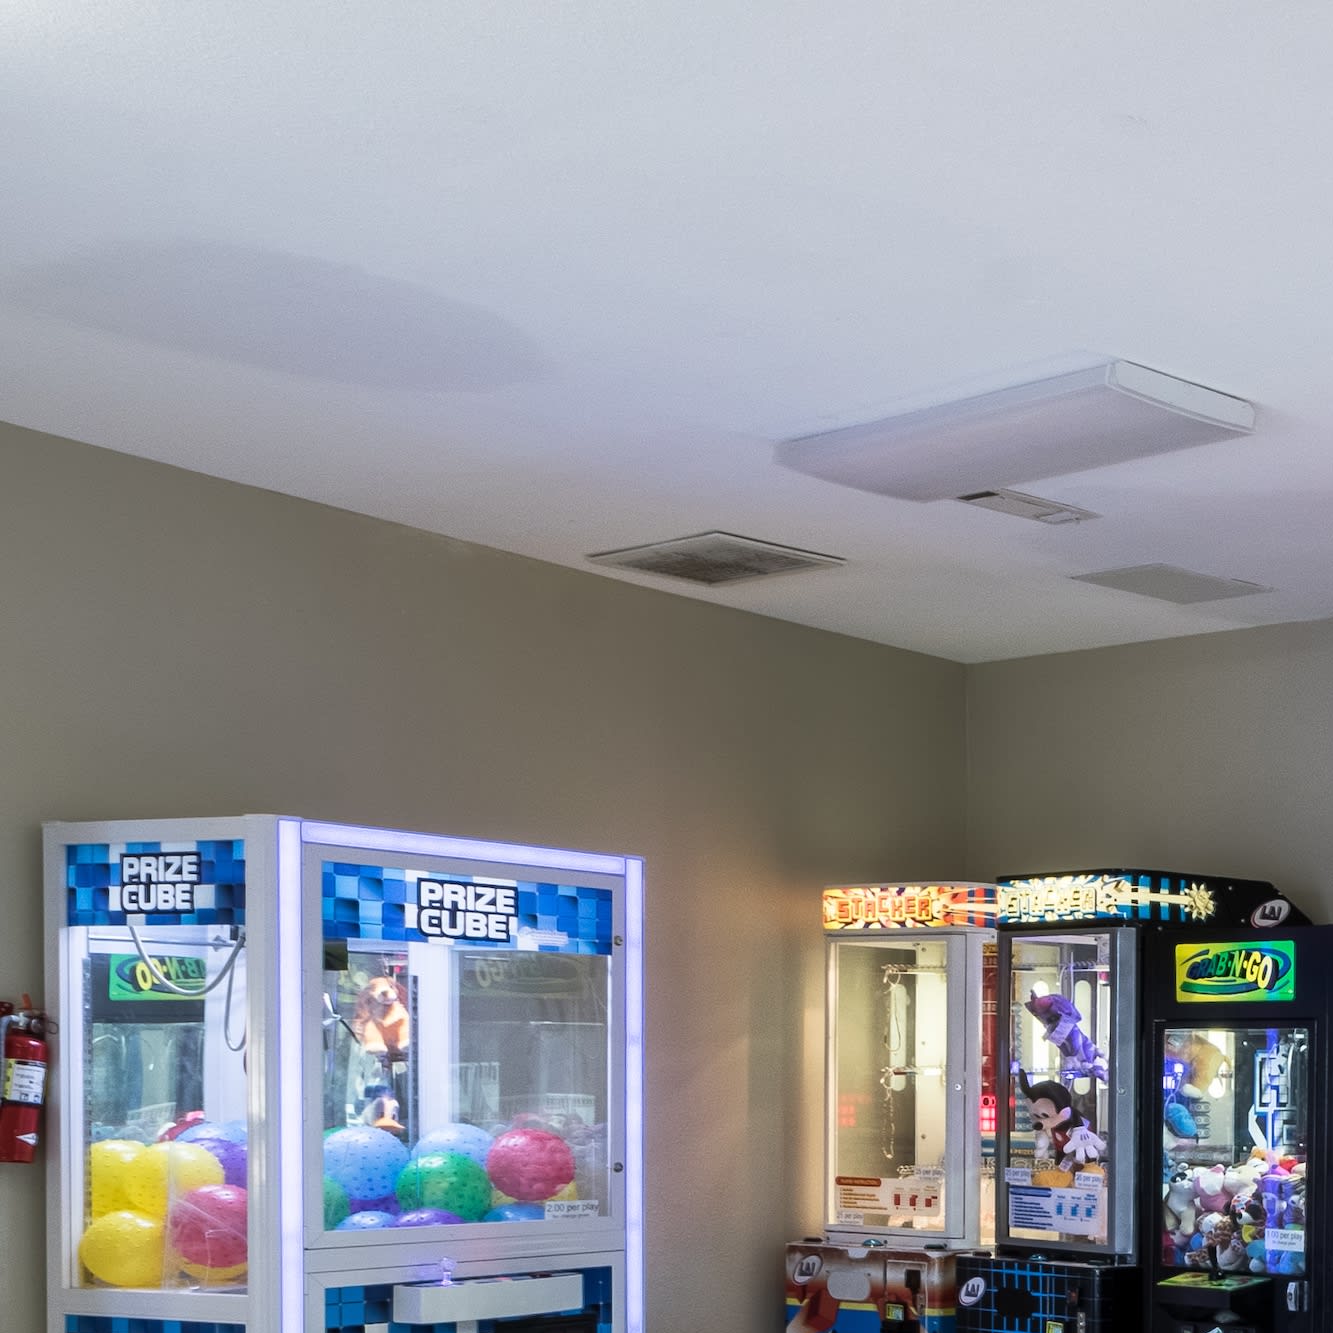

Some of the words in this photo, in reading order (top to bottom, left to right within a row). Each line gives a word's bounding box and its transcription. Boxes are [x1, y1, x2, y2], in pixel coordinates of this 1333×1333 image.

[123, 855, 198, 882] PRIZE
[122, 884, 192, 911] CUBE
[420, 881, 516, 912] PRIZE
[837, 895, 932, 921] STACKER
[1260, 905, 1282, 920] LAI
[420, 909, 509, 938] CUBE
[546, 1203, 565, 1213] 2.00
[567, 1204, 581, 1213] per
[582, 1203, 600, 1213] play
[1281, 1232, 1290, 1242] per
[1291, 1231, 1303, 1242] play
[797, 1262, 816, 1276] LAI
[965, 1283, 980, 1297] LAI
